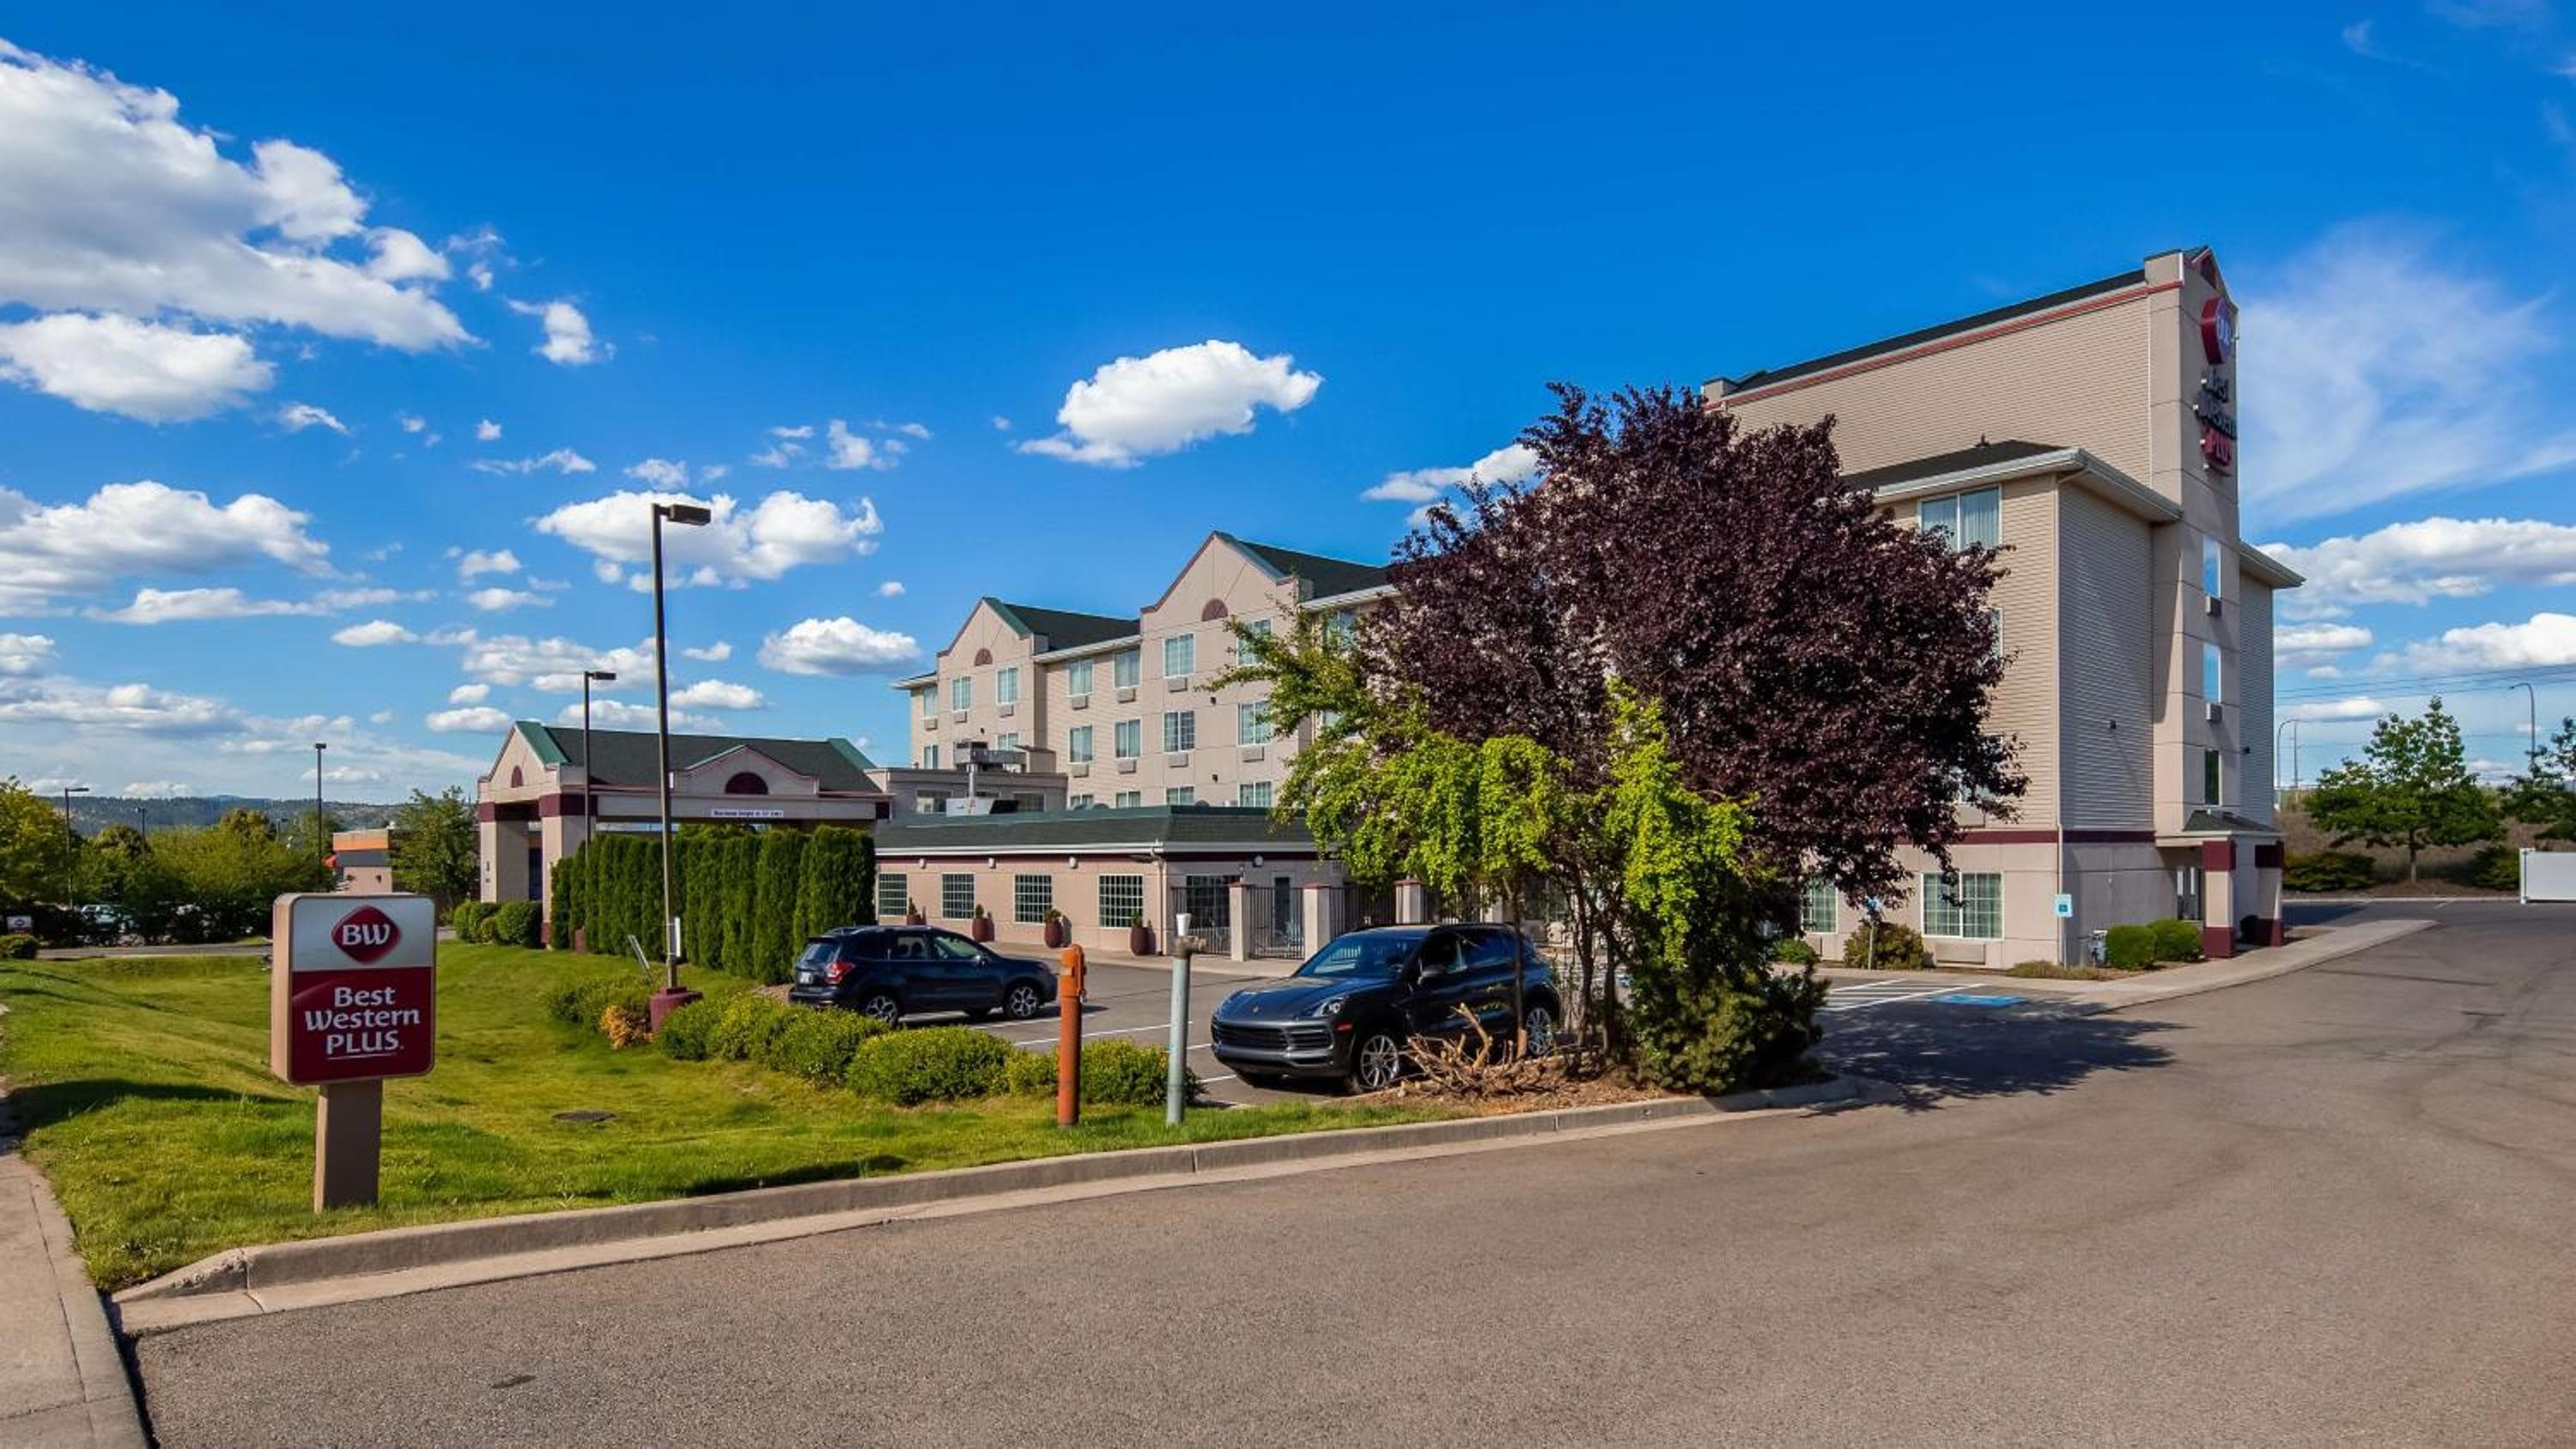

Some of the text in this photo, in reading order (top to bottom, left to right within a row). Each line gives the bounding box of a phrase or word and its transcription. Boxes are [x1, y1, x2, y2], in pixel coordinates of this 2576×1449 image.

[343, 923, 391, 946] BW
[334, 986, 396, 1008] Best
[305, 1009, 420, 1031] Western
[326, 1030, 399, 1055] PLUS
